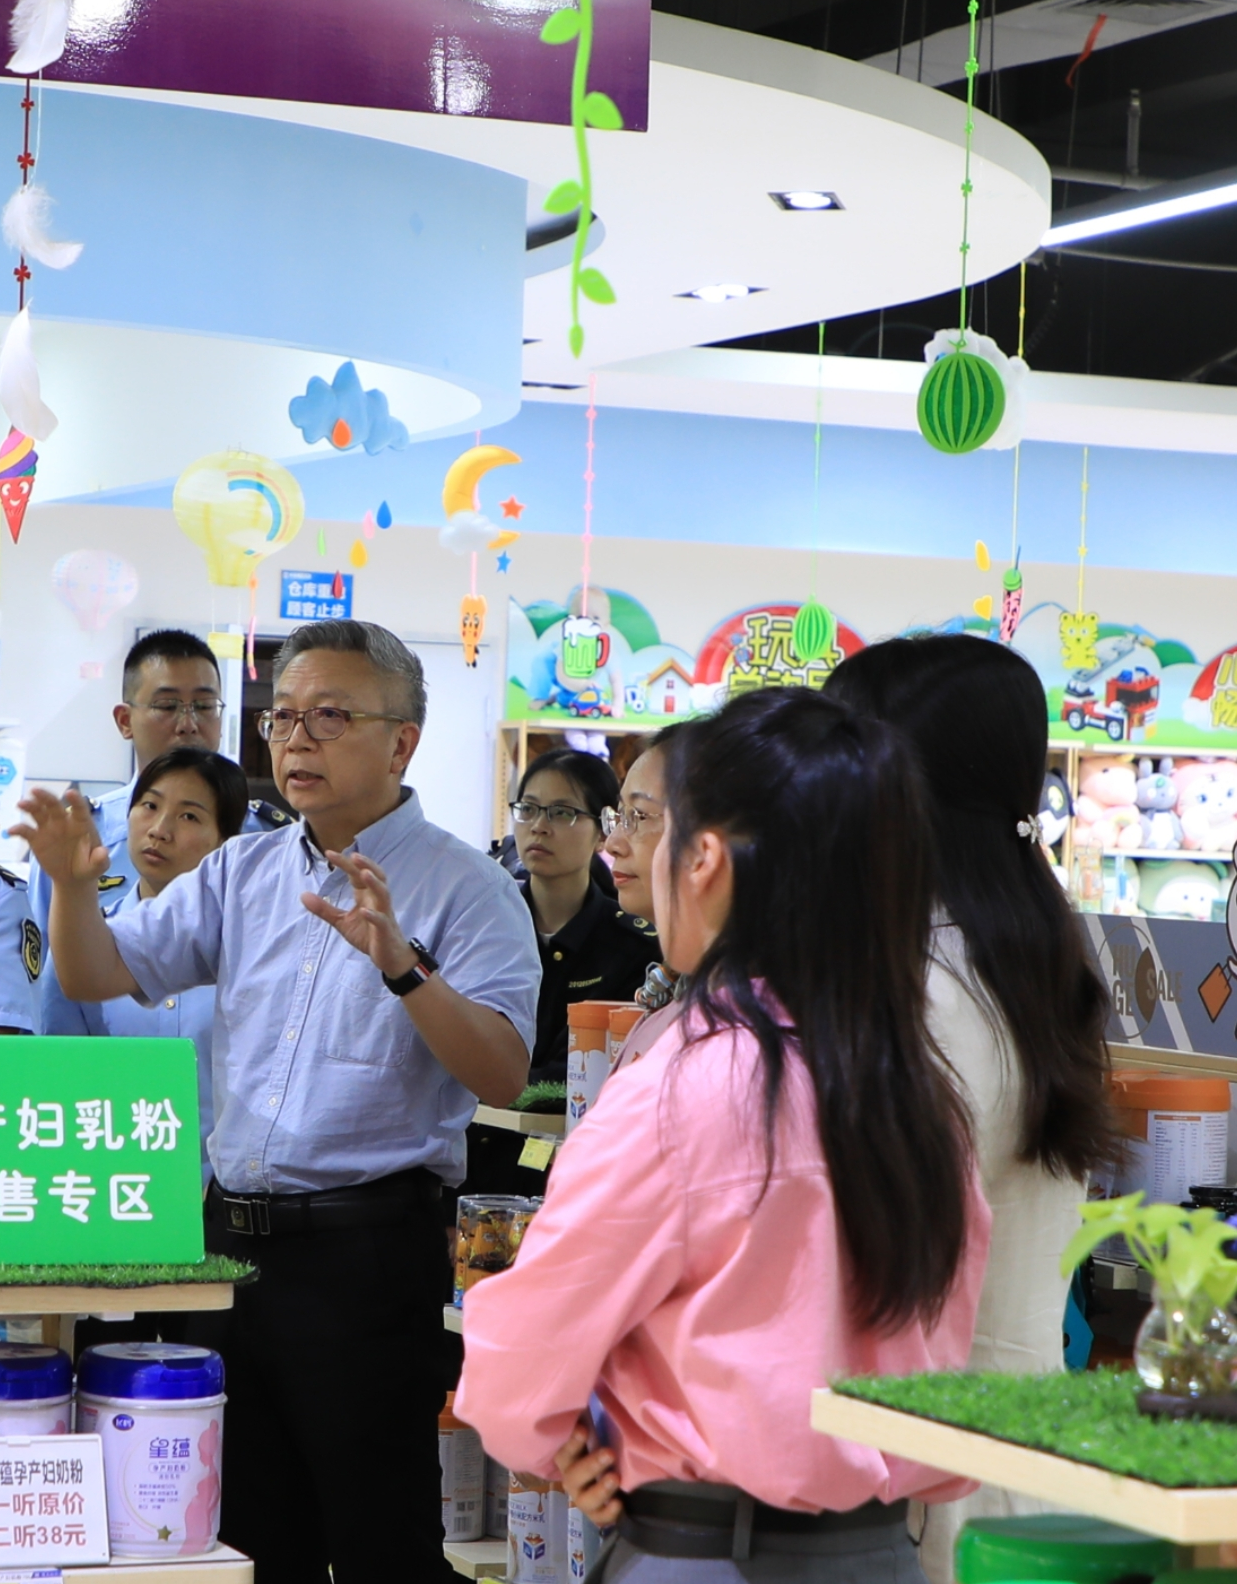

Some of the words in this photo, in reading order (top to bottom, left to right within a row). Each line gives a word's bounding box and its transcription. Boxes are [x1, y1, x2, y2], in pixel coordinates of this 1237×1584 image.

[288, 581, 346, 600] 仓库重
[287, 601, 345, 618] 顾客止步
[1146, 968, 1182, 1003] SALE
